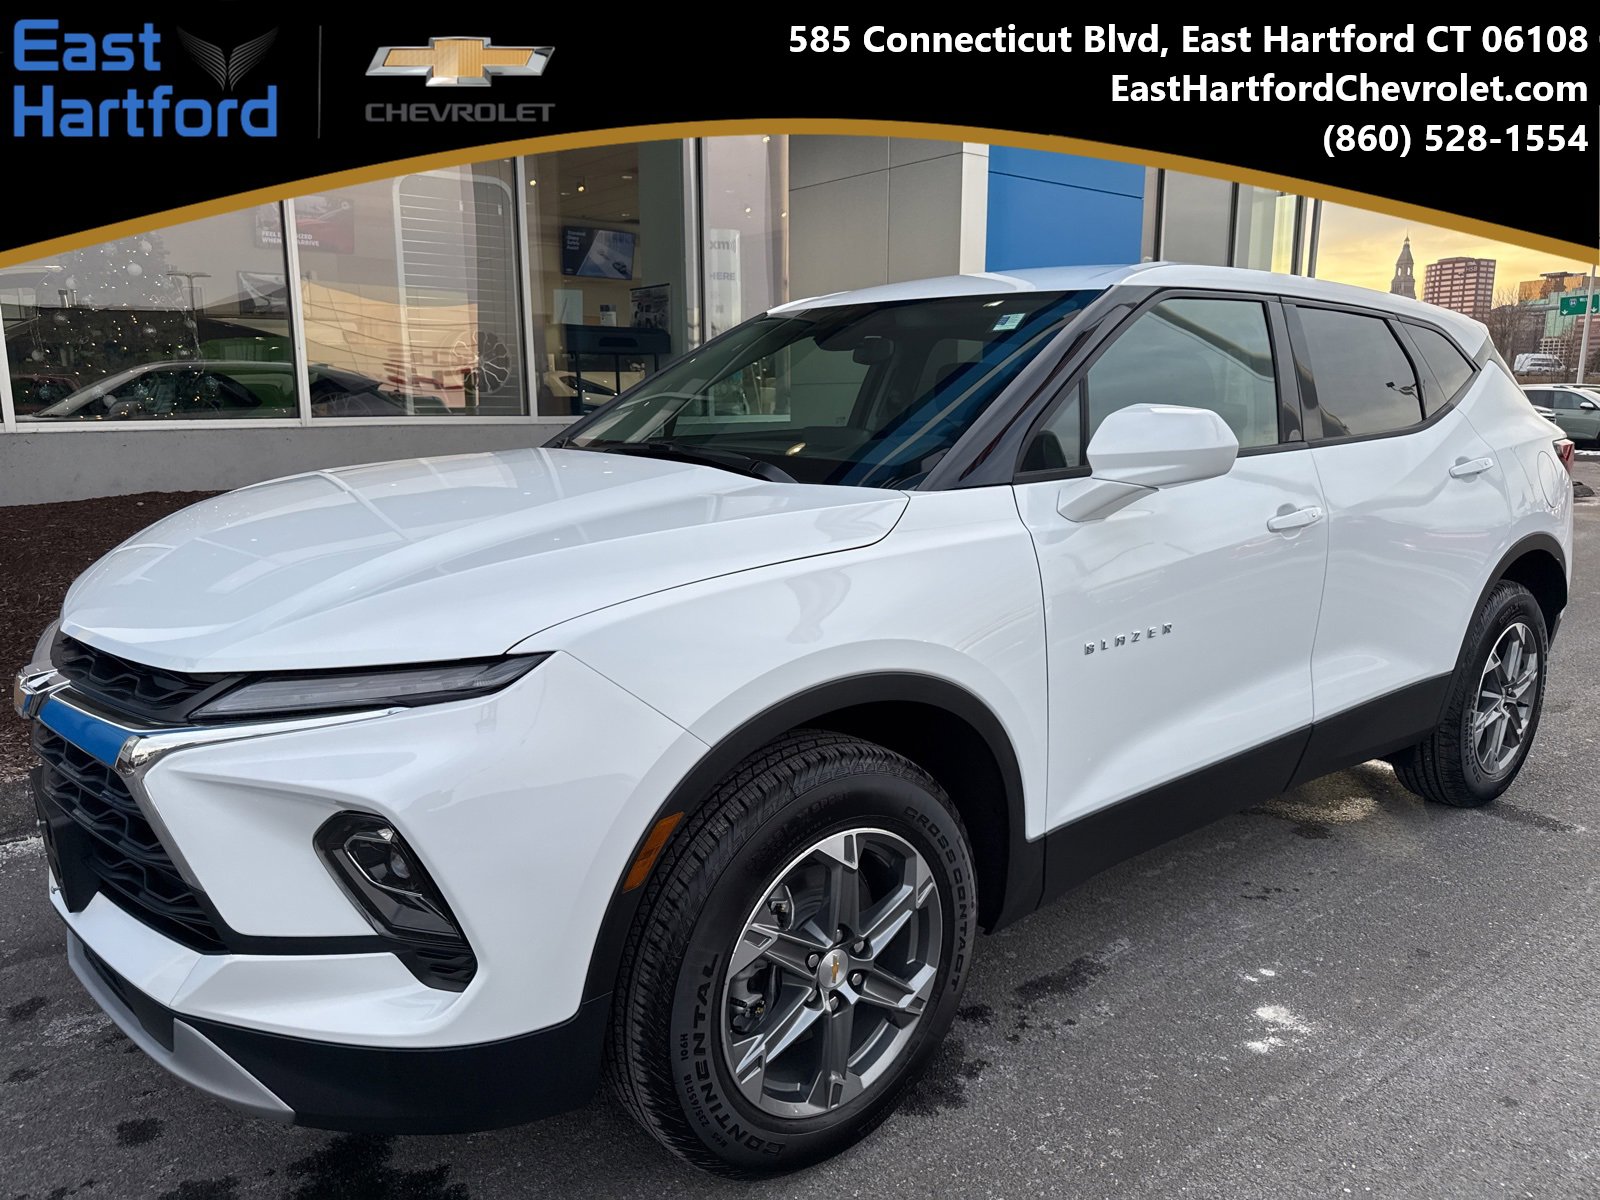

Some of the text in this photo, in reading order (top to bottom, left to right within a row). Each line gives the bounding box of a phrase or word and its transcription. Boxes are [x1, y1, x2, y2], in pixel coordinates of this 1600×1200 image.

[1083, 621, 1173, 656] BLAZER
[903, 806, 957, 865] CROSS
[953, 868, 967, 993] CONTACT
[680, 1032, 689, 1061] 106H
[692, 953, 786, 1155] CONTINENTAL
